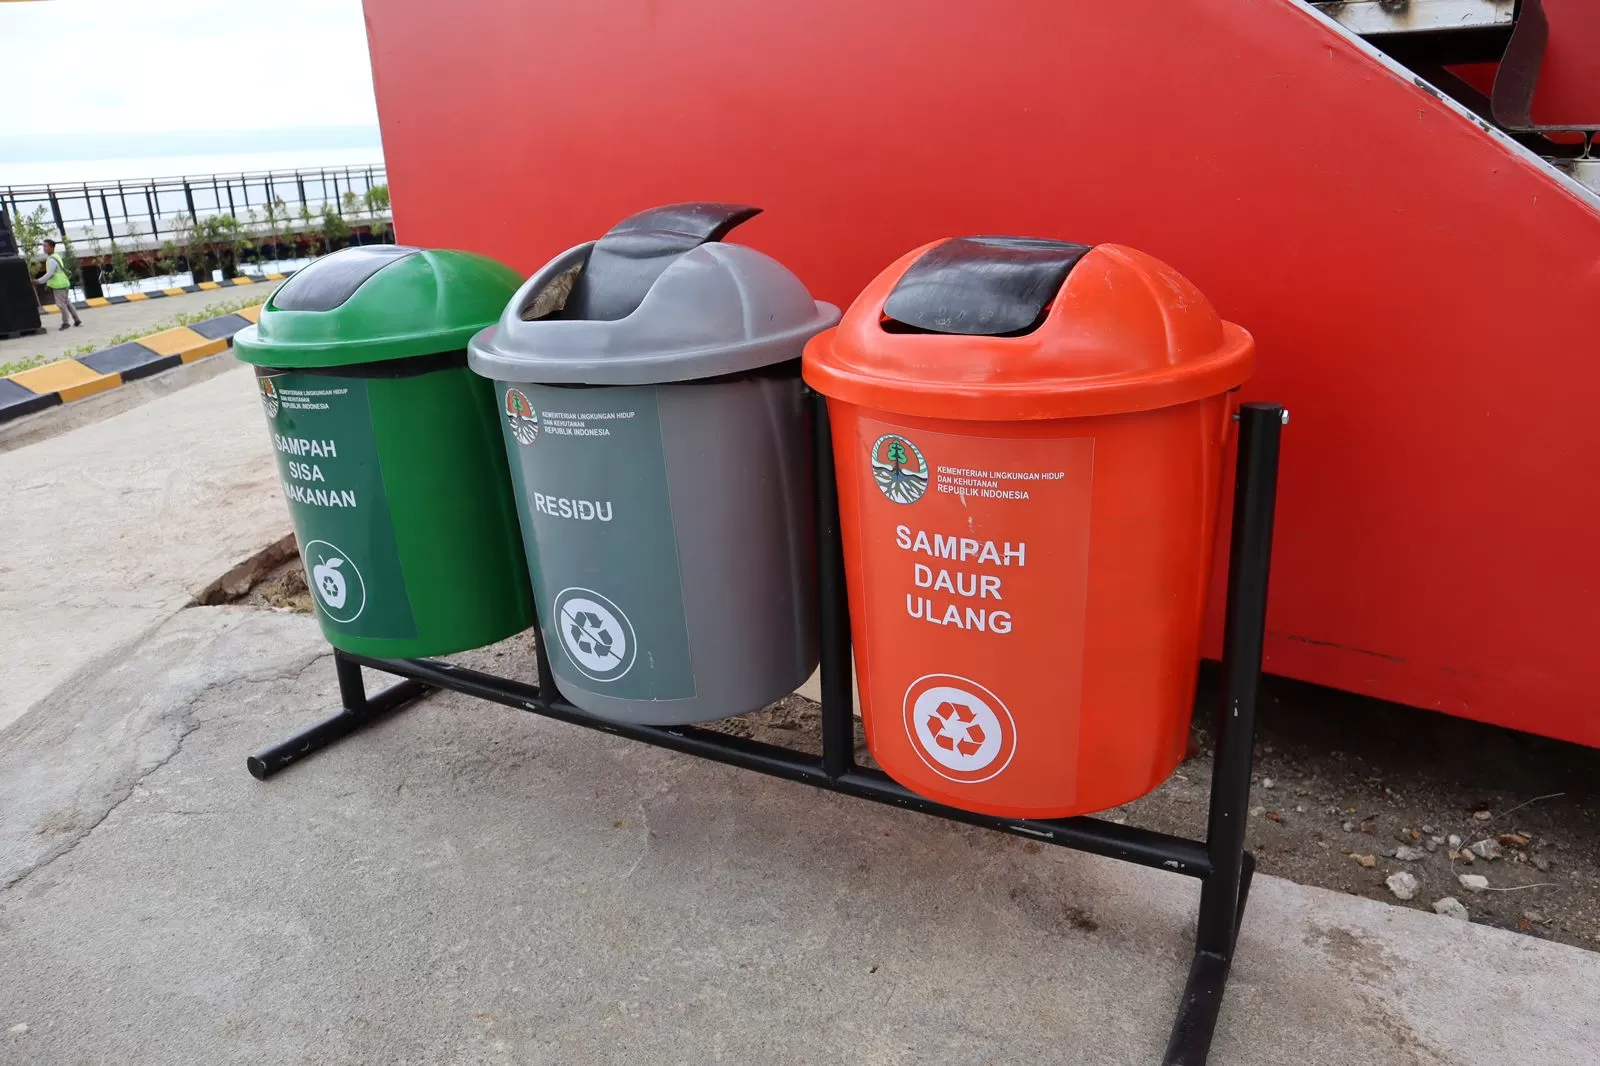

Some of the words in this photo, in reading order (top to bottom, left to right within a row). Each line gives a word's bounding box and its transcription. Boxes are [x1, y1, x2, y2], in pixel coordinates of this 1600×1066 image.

[616, 411, 635, 419] HIDUP
[544, 426, 573, 436] REPUBLIK
[573, 427, 610, 436] INDONESIA
[274, 433, 337, 458] SAMPAH
[288, 460, 325, 482] SISA
[937, 465, 988, 478] KEMENTERIAN
[989, 471, 1040, 481] LINGKUNGAN
[1041, 471, 1065, 480] HIDUP
[937, 475, 952, 483] DAN
[953, 478, 998, 488] KEHUTANAN
[937, 483, 979, 497] REPUBLIK
[981, 488, 1029, 500] INDONESIA
[533, 491, 613, 522] RESIDU
[896, 525, 1026, 567] SAMPAH
[914, 563, 1002, 600] DAUR
[906, 593, 1012, 634] ULANG
